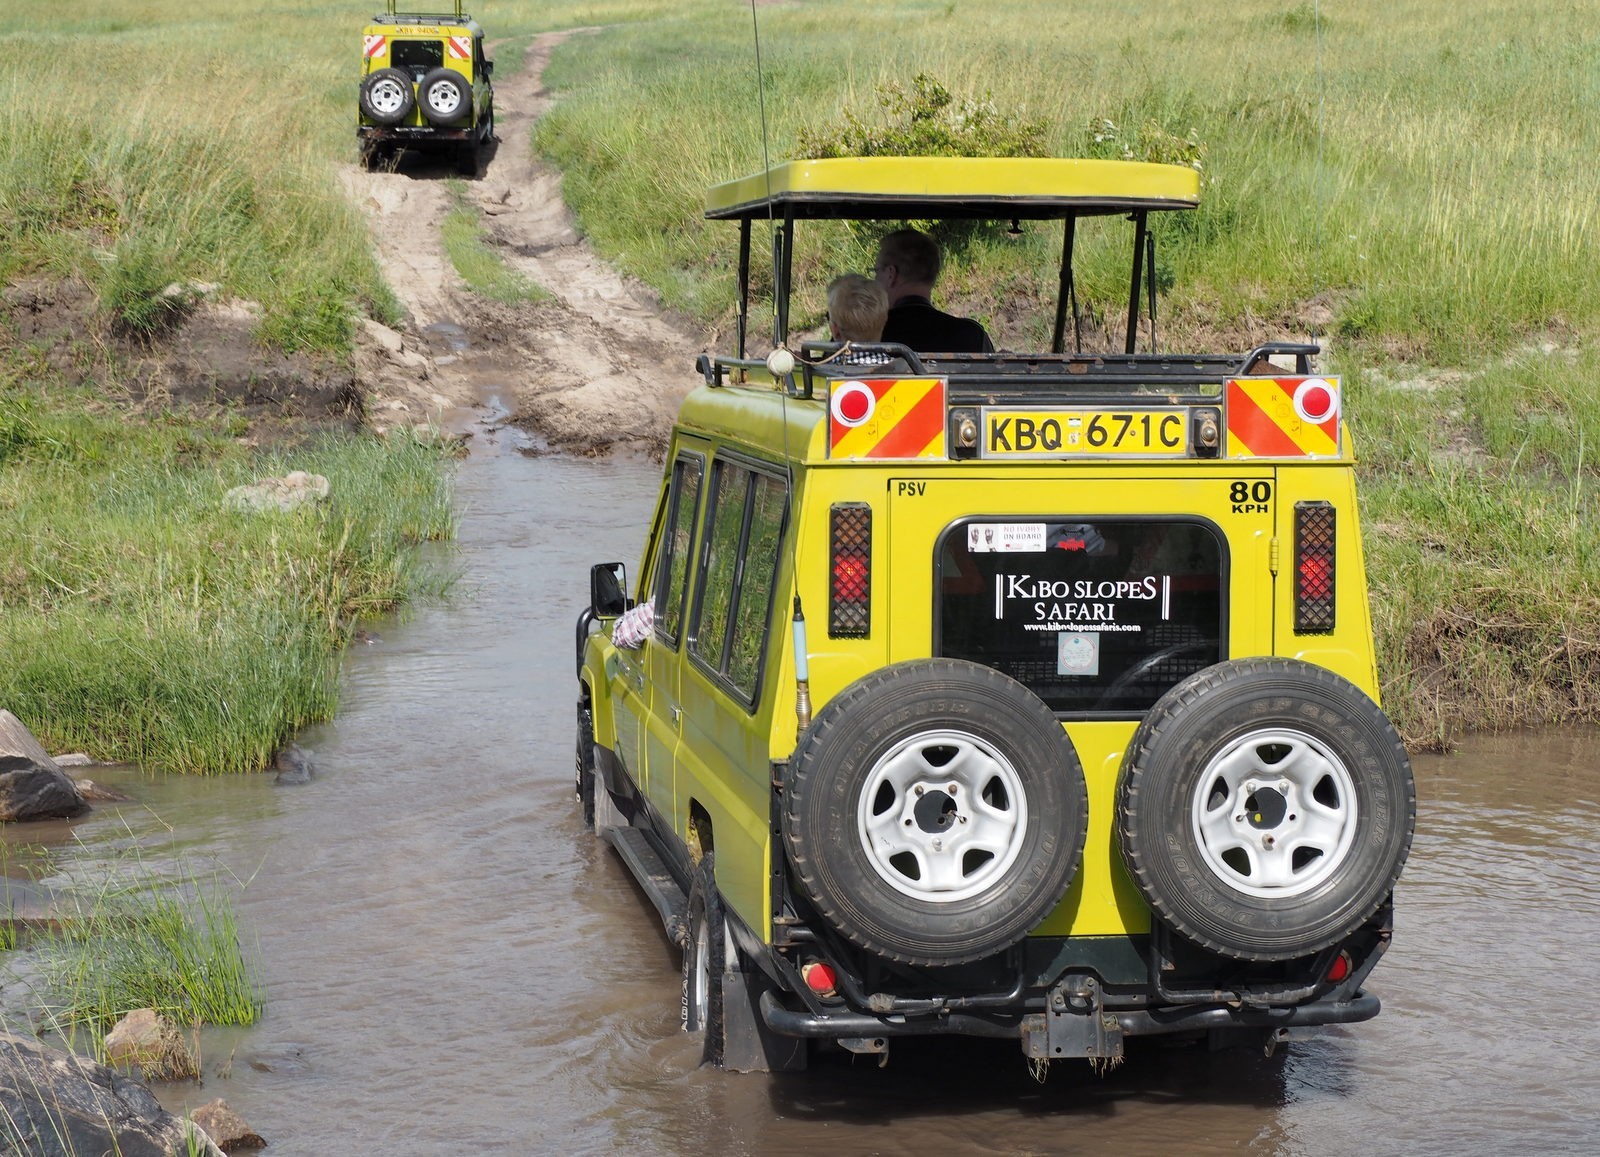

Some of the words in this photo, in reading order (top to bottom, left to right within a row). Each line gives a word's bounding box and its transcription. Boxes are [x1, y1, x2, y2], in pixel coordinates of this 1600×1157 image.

[990, 418, 1062, 451] KBQ
[1086, 415, 1181, 447] 671C
[898, 481, 926, 496] PSV
[1229, 481, 1271, 503] 80
[1232, 504, 1268, 513] KPH
[1074, 576, 1157, 600] SLOPES
[1034, 602, 1115, 621] SAFARI
